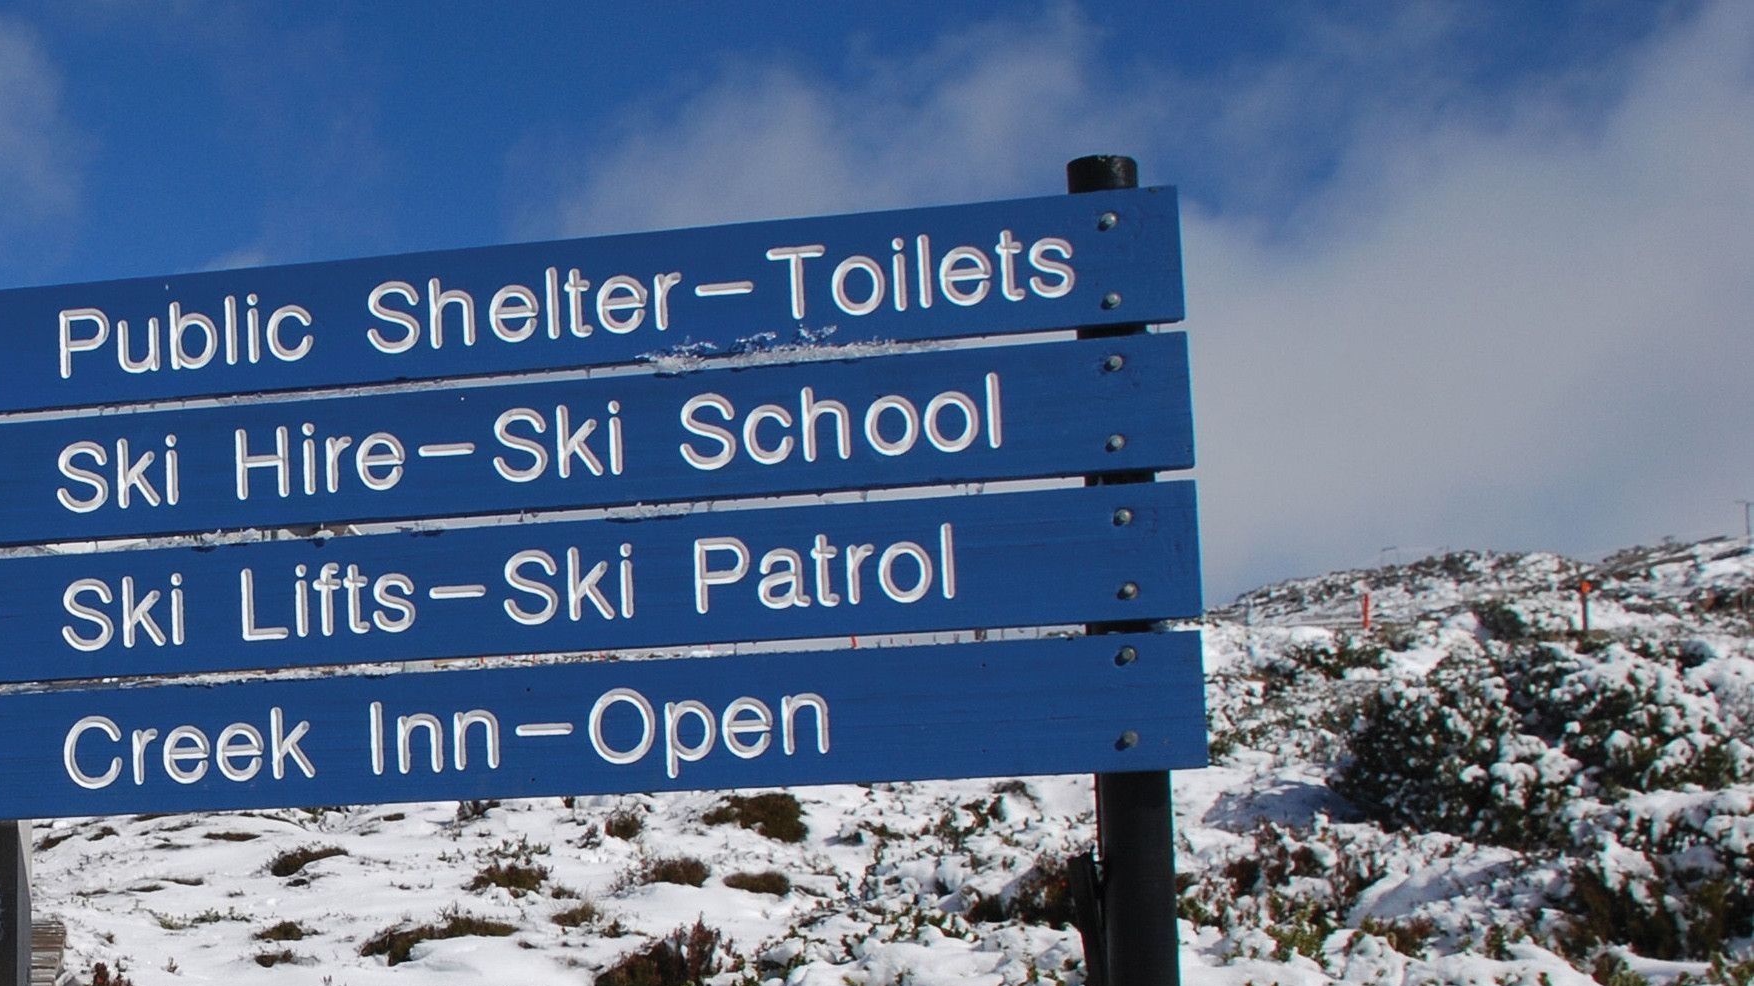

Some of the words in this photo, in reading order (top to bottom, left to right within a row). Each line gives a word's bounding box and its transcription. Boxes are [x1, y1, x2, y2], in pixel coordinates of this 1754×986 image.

[58, 293, 314, 379] Public
[56, 434, 179, 514] Ski
[679, 372, 1002, 471] School
[61, 573, 185, 652] Ski
[694, 523, 955, 614] Patrol
[63, 707, 316, 790] Creek
